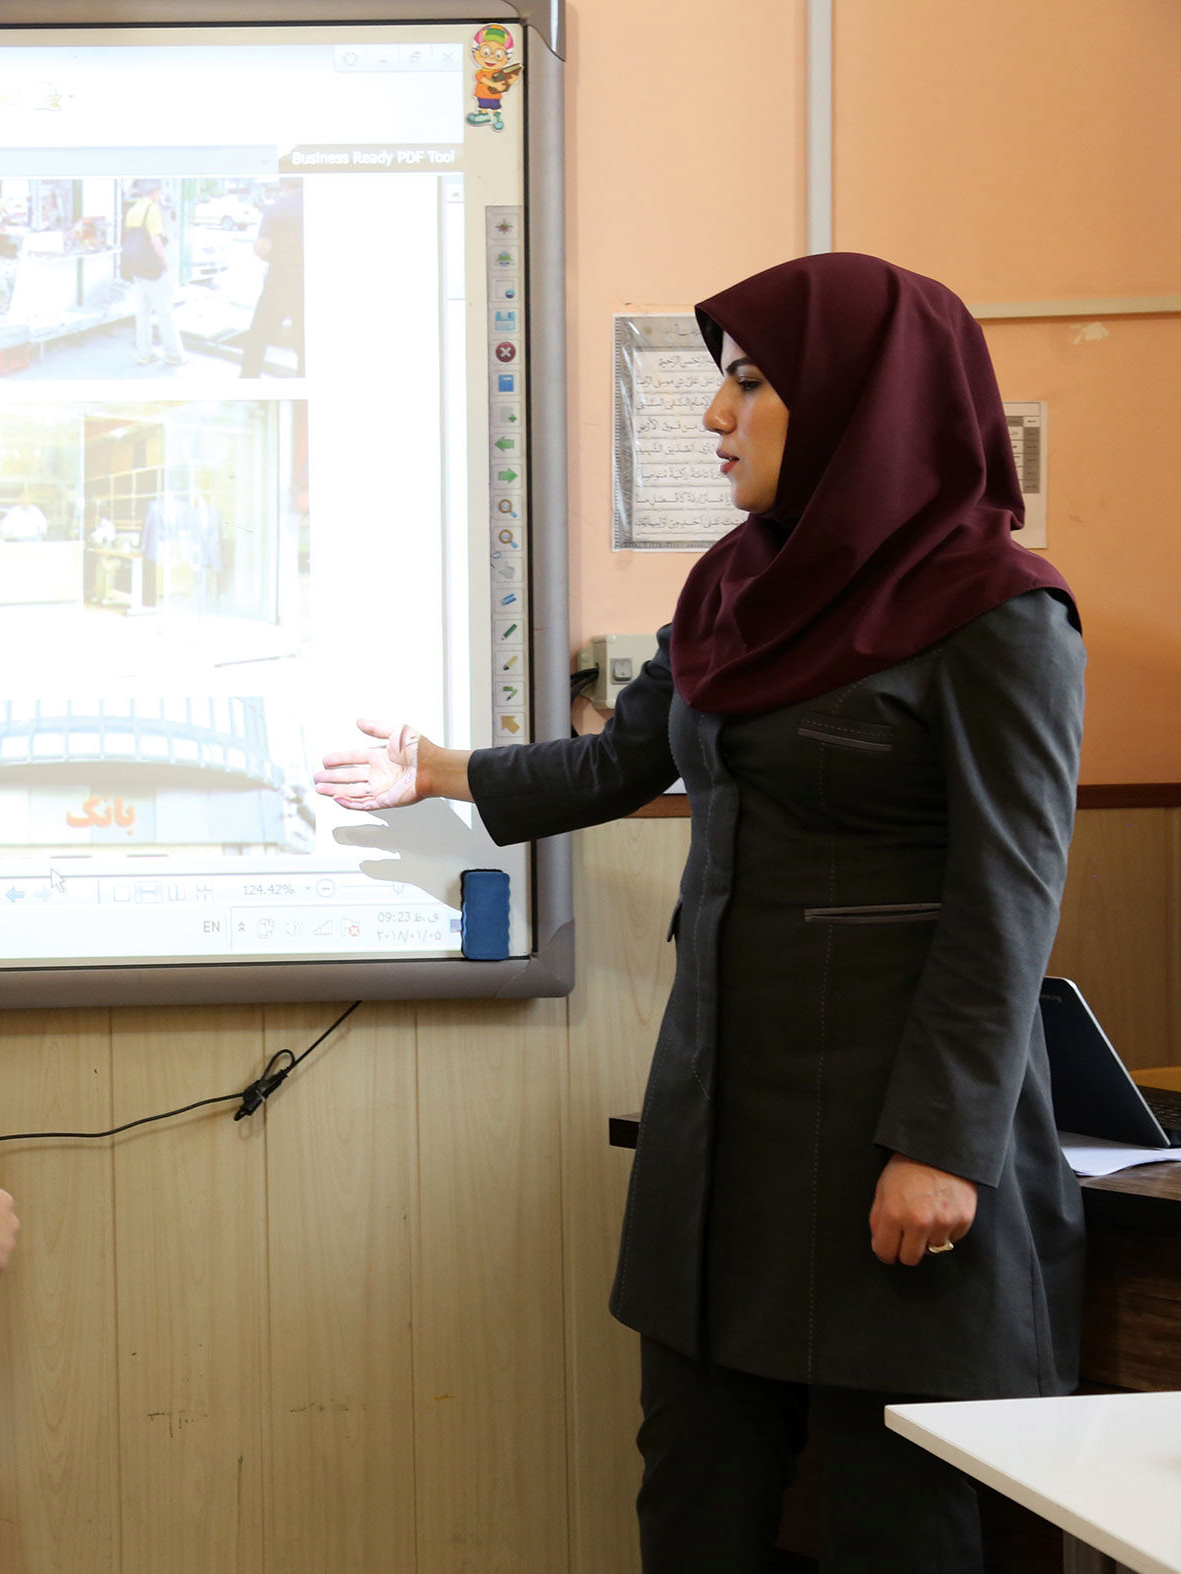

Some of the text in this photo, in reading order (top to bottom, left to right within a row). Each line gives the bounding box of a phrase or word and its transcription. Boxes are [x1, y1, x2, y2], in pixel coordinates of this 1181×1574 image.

[291, 150, 456, 167] Business Ready PDF Tool
[65, 795, 137, 837] بانک
[243, 882, 297, 896] 124.42%
[377, 911, 411, 924] 09:23
[202, 920, 221, 934] EN
